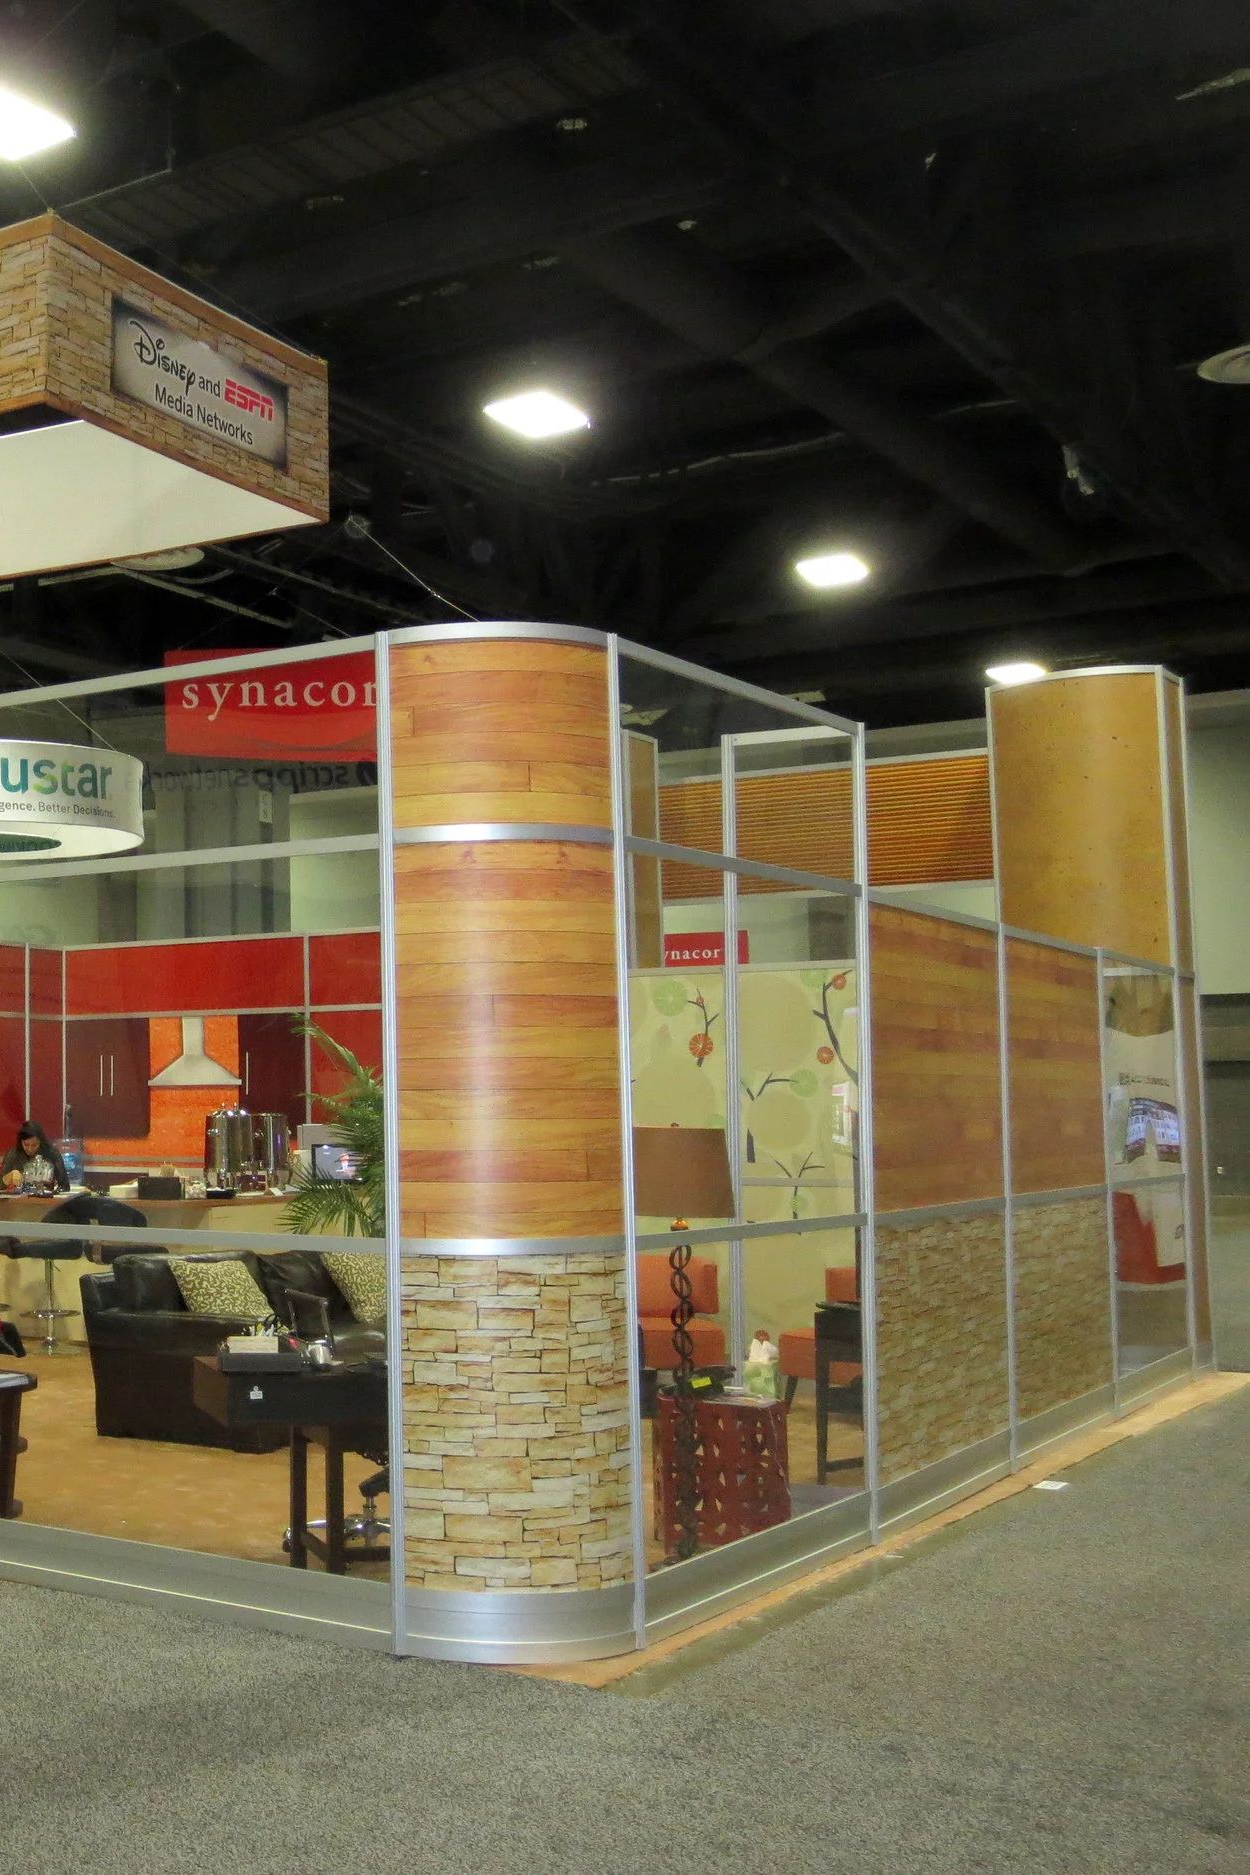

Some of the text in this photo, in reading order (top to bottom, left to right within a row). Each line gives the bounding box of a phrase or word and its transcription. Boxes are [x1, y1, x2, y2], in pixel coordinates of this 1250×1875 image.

[155, 383, 253, 446] Media Networks
[199, 375, 221, 398] and
[224, 378, 275, 422] ESPN
[182, 680, 377, 722] synacor
[38, 801, 71, 814] Better
